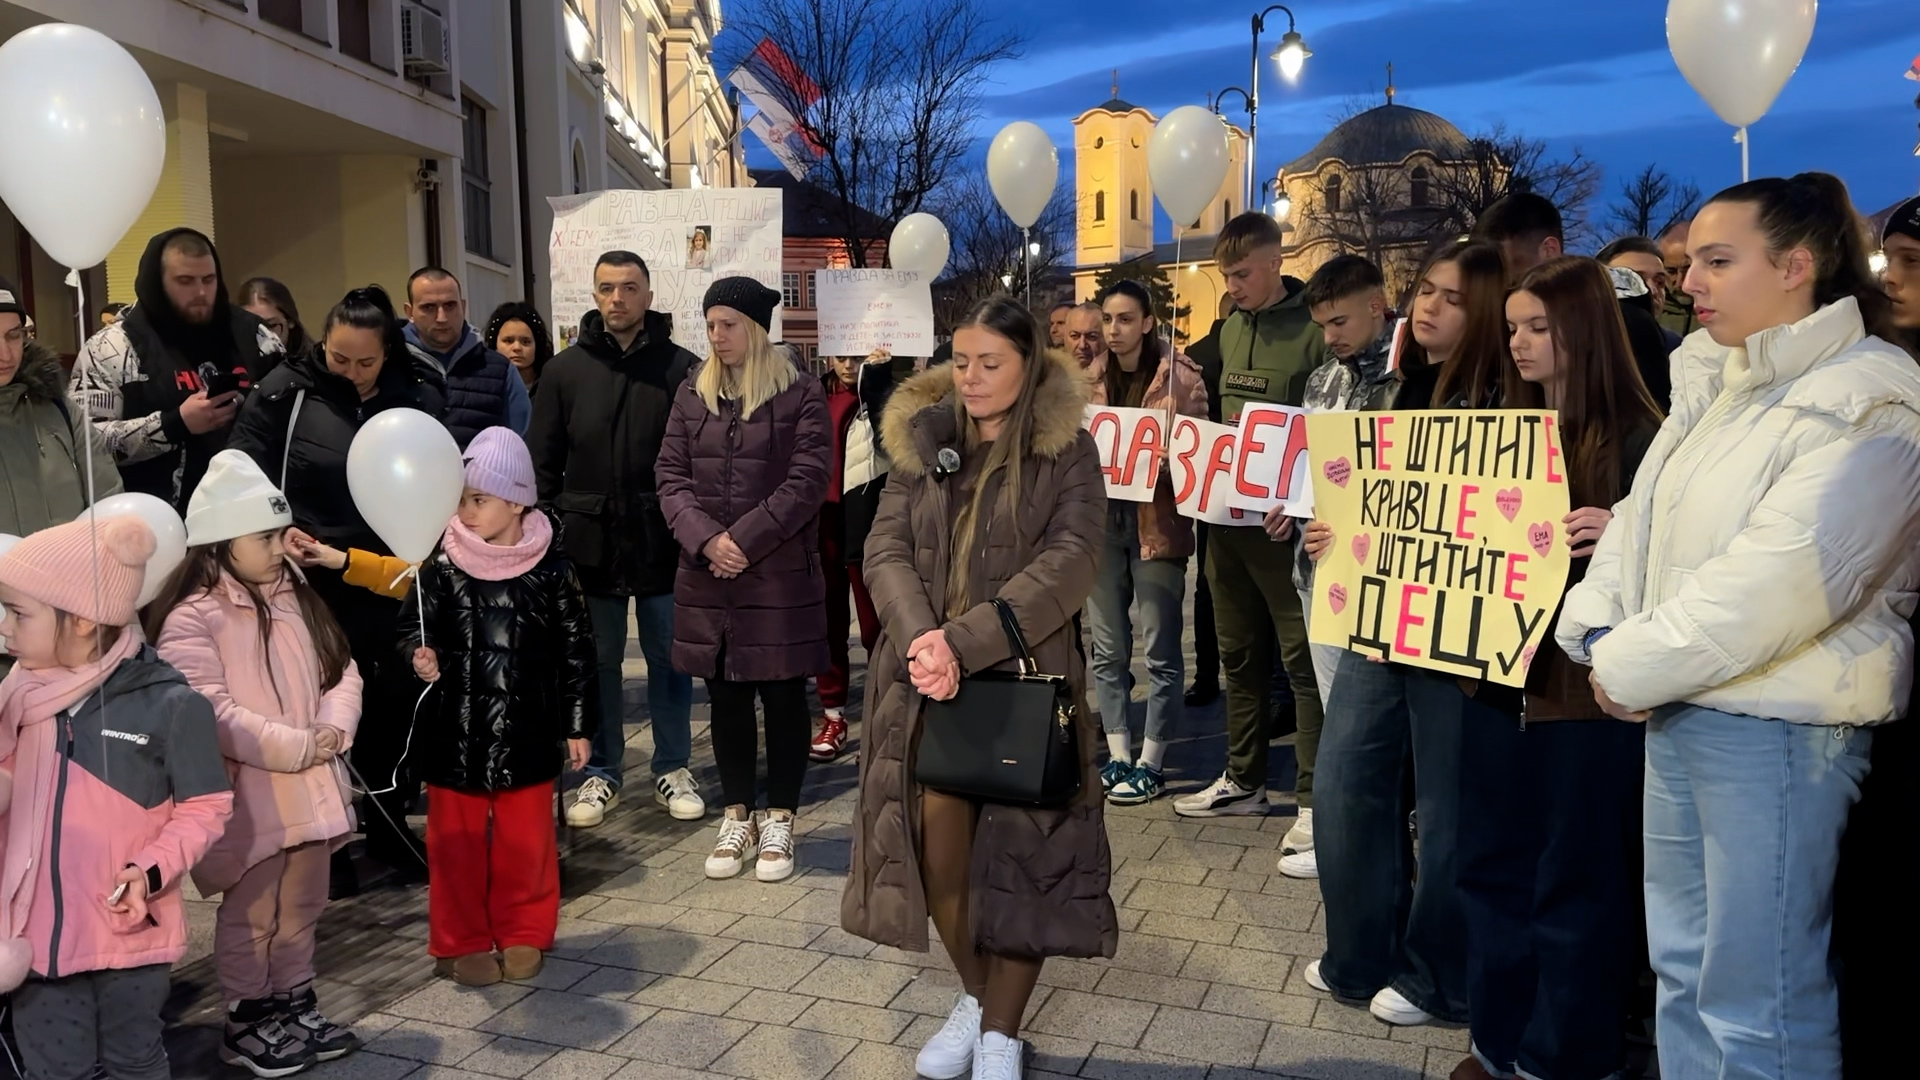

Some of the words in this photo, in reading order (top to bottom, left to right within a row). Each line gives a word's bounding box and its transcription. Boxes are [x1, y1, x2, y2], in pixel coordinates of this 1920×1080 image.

[636, 228, 679, 268] ЗА
[733, 225, 748, 243] НЕ
[826, 269, 878, 285] ПРАВДА
[897, 270, 919, 283] ЕМУ
[1355, 416, 1395, 471] НЕ
[1405, 416, 1563, 483] ШТИТИТЕ
[1534, 531, 1549, 542] ЕМА
[1376, 532, 1529, 601] ШТИТИТЕ
[1348, 576, 1545, 680] ДЕЦУ
